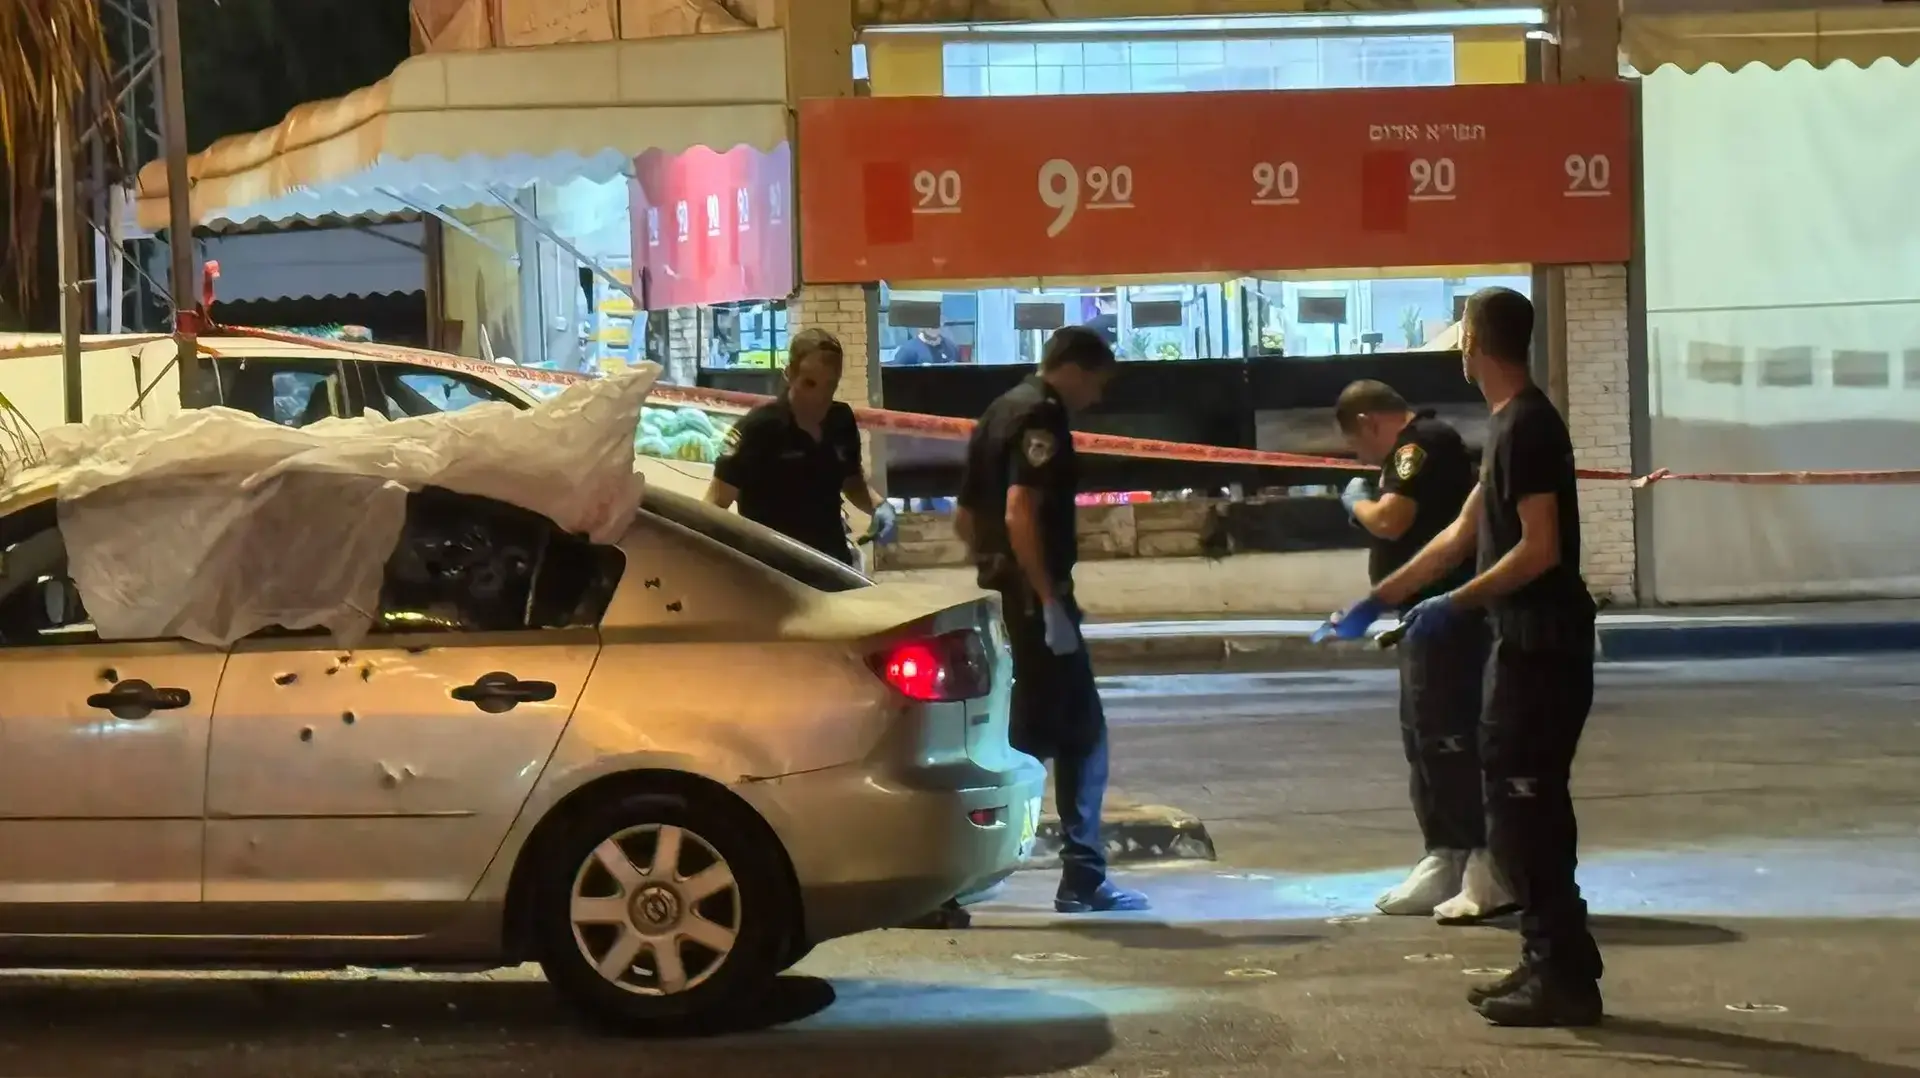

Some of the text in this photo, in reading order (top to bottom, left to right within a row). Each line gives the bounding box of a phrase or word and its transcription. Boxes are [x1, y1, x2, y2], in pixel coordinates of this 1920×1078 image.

[1369, 123, 1419, 141] אדום
[913, 170, 962, 208] 90
[1252, 162, 1299, 199] 90
[1410, 157, 1456, 195] 90
[1563, 154, 1610, 191] 90
